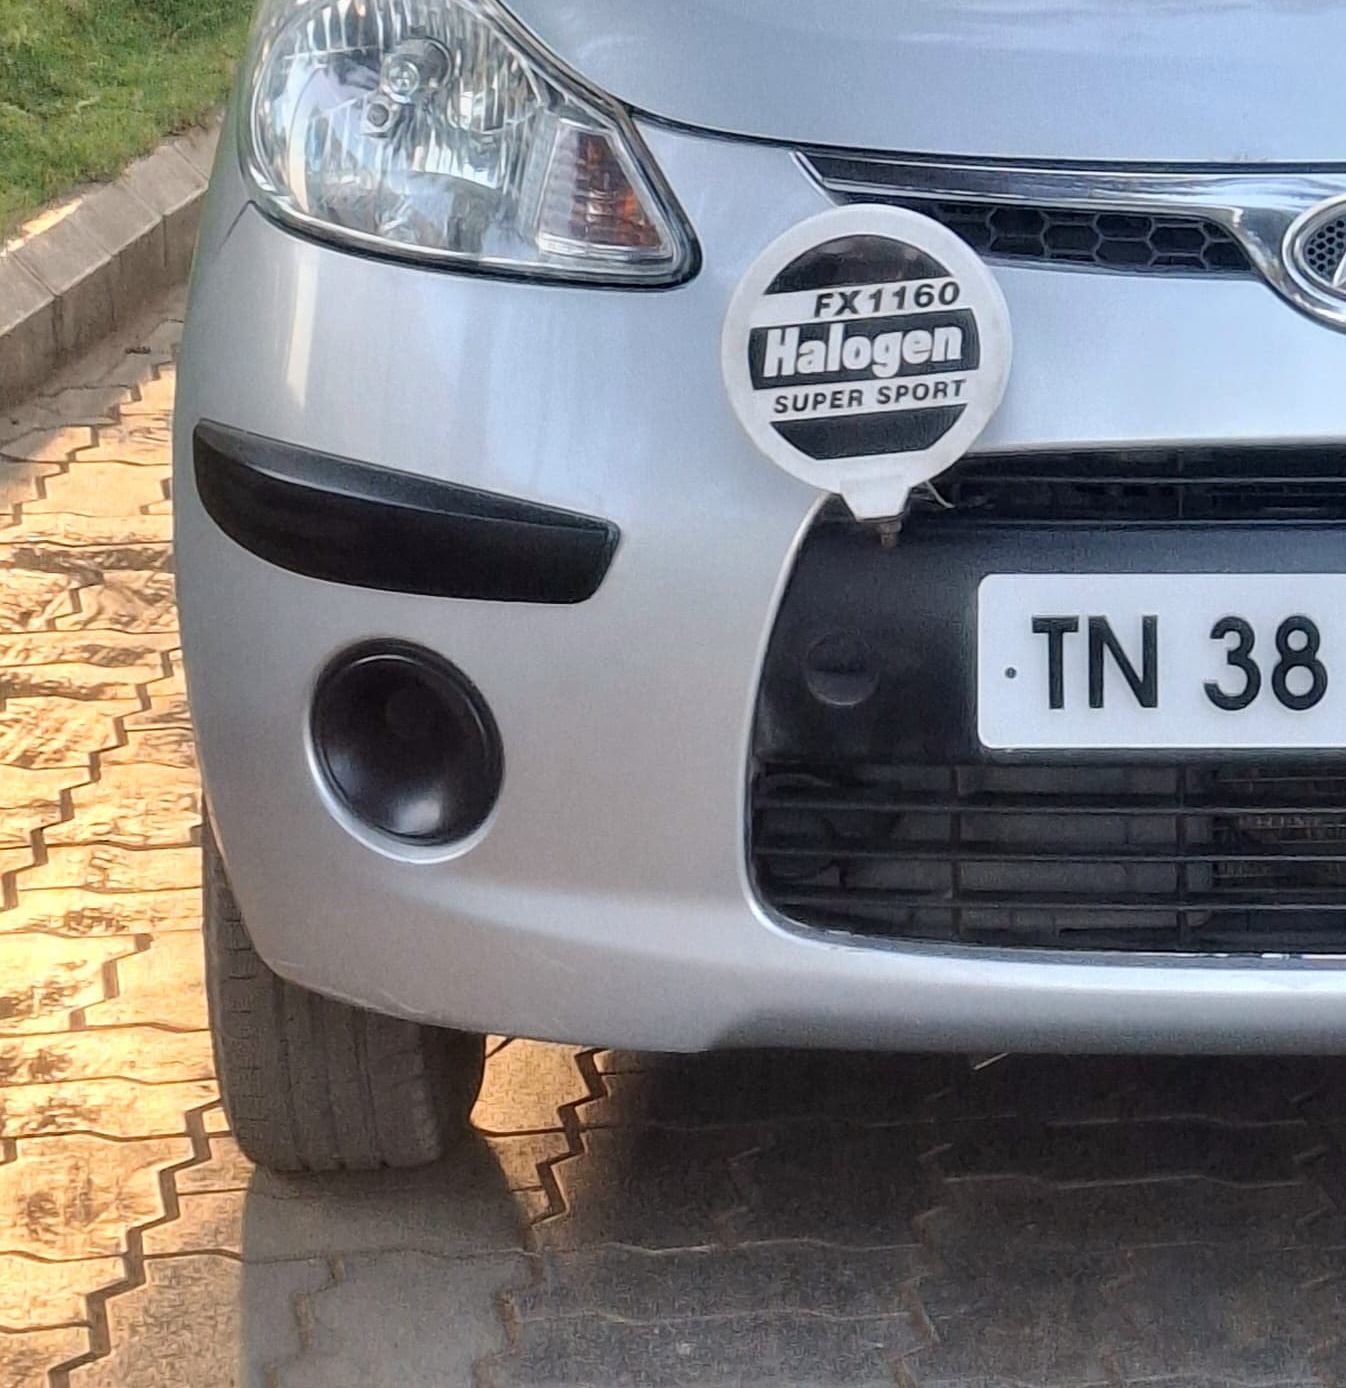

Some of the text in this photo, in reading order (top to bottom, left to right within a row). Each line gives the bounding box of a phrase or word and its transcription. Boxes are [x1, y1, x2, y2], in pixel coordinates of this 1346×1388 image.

[815, 281, 960, 318] FX1160
[762, 322, 964, 379] Halogen
[773, 378, 967, 414] SUPER SPORT
[1031, 615, 1159, 710] TN
[1203, 615, 1329, 712] 38
